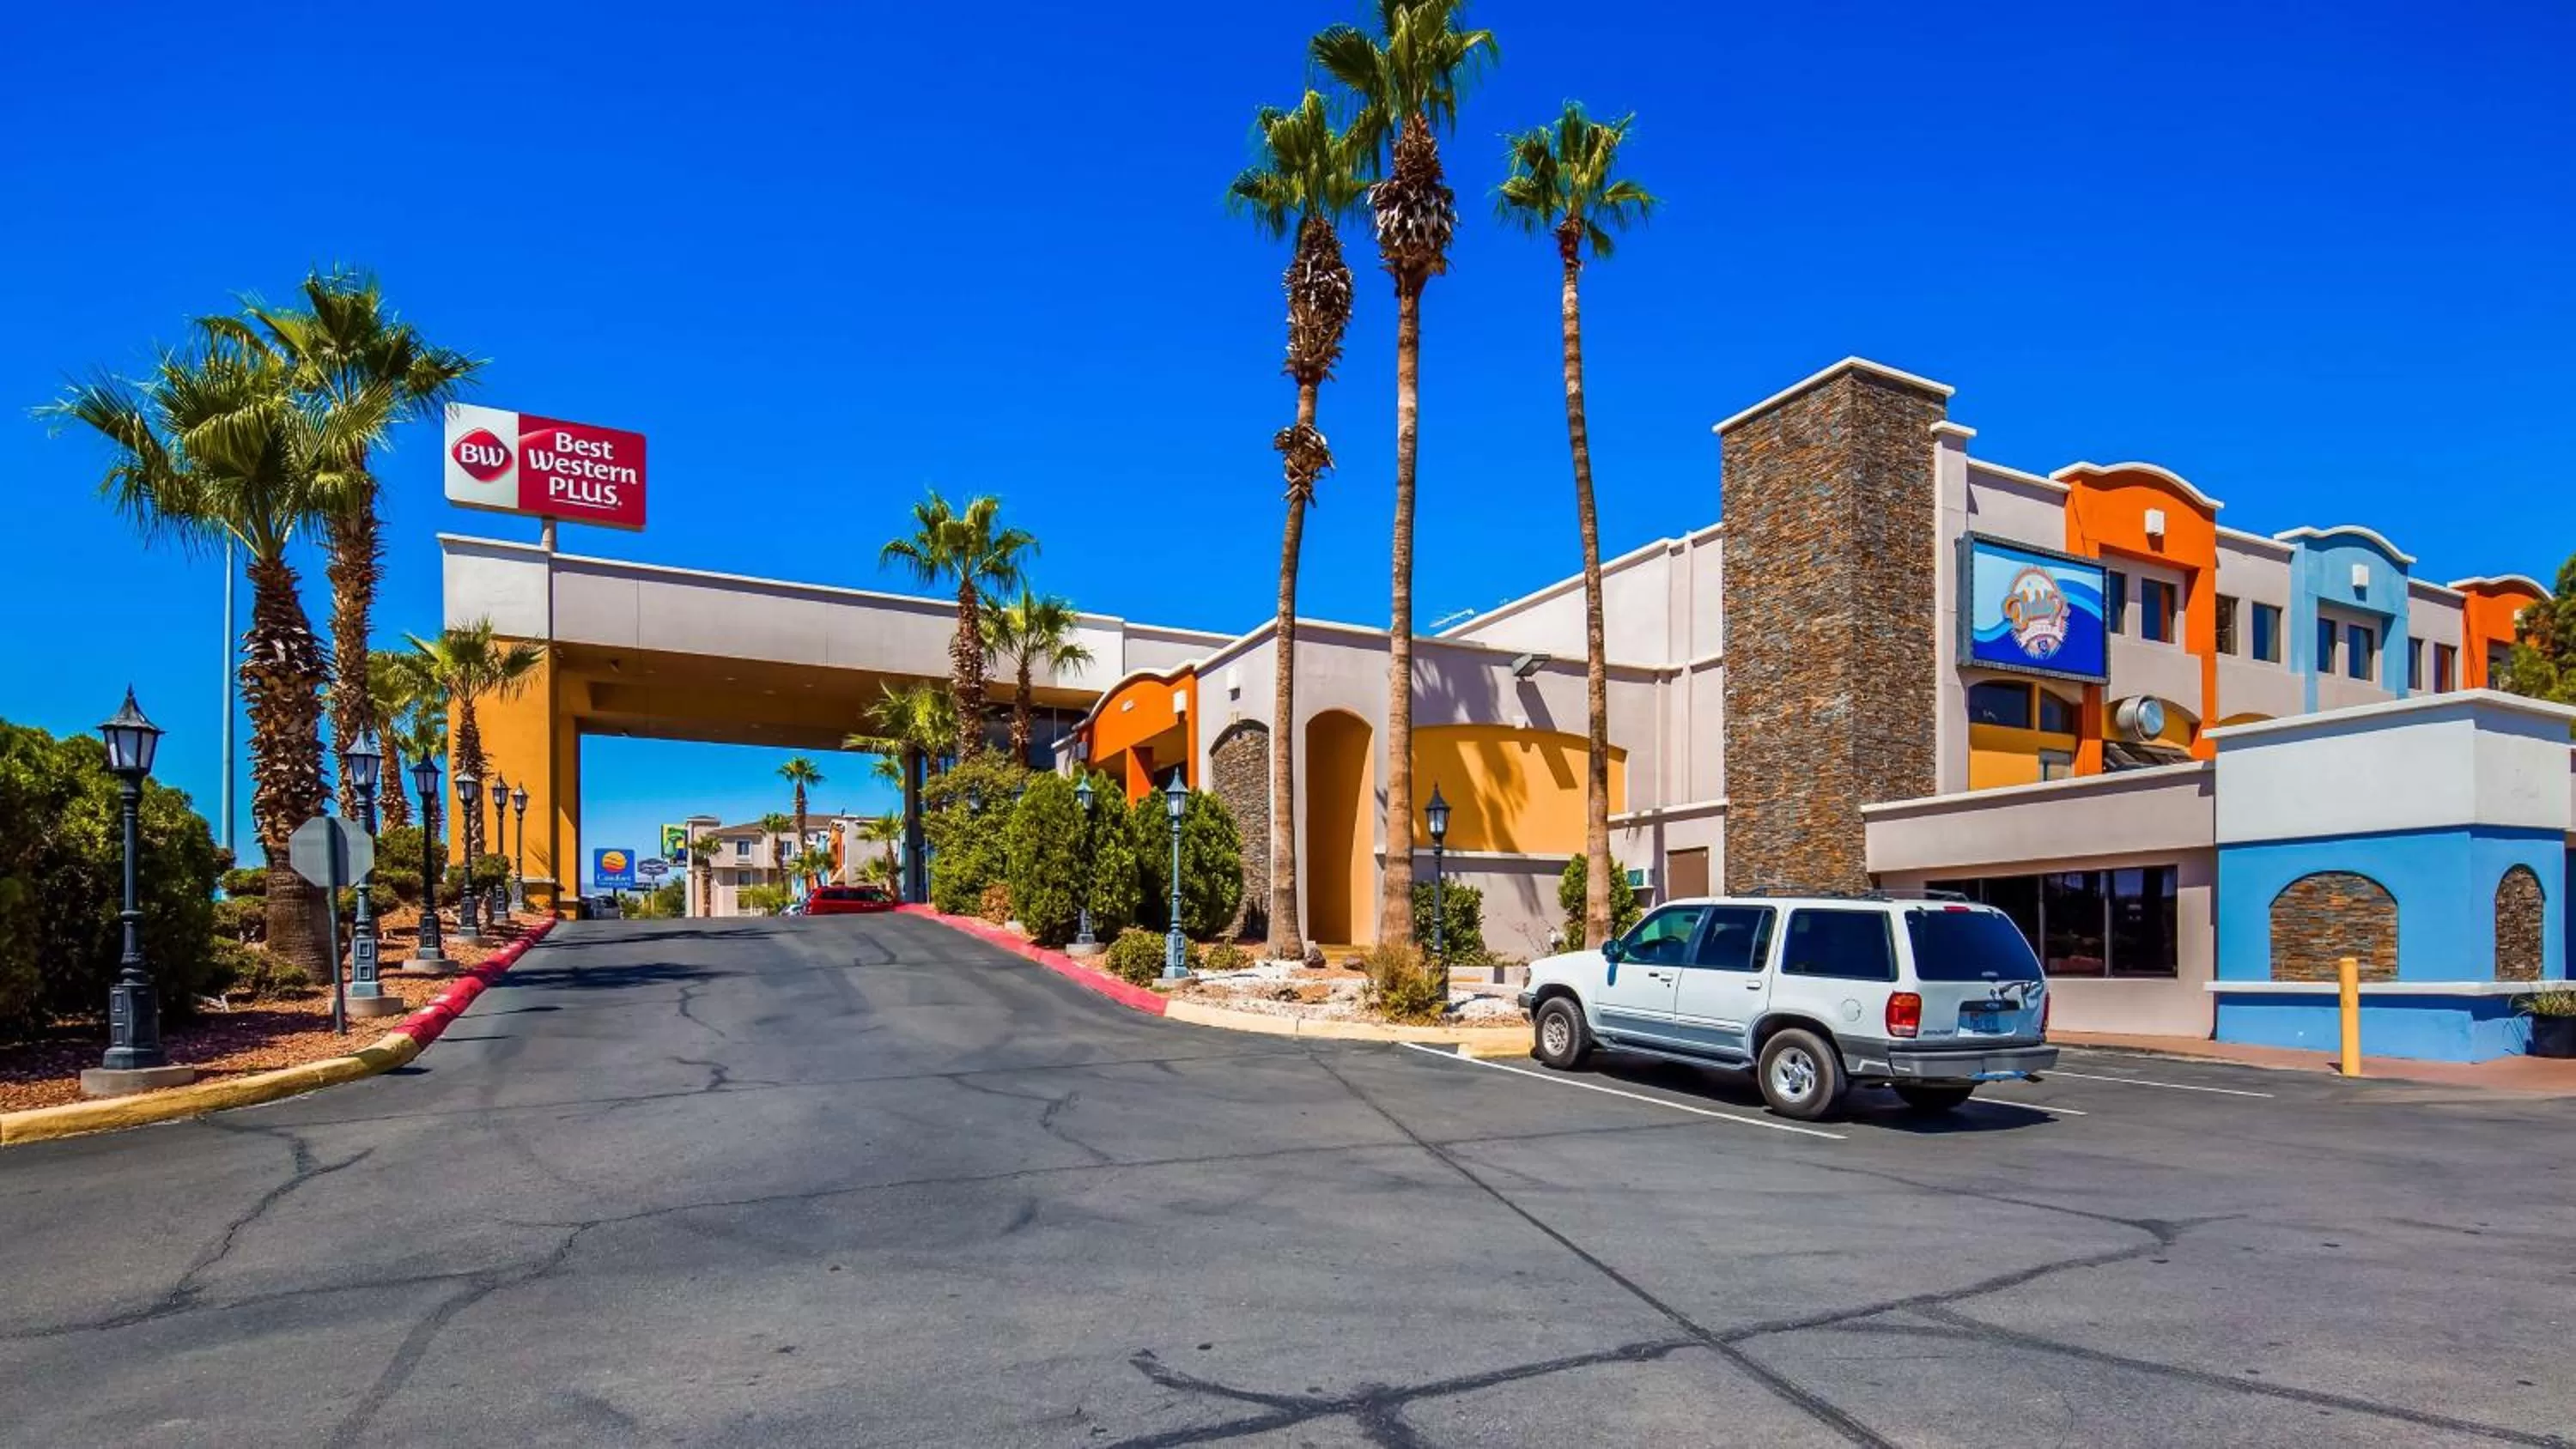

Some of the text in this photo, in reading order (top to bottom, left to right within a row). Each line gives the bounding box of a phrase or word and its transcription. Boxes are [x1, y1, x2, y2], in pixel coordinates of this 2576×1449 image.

[459, 442, 505, 467] BW
[556, 432, 614, 460] Best
[528, 448, 638, 485] Western
